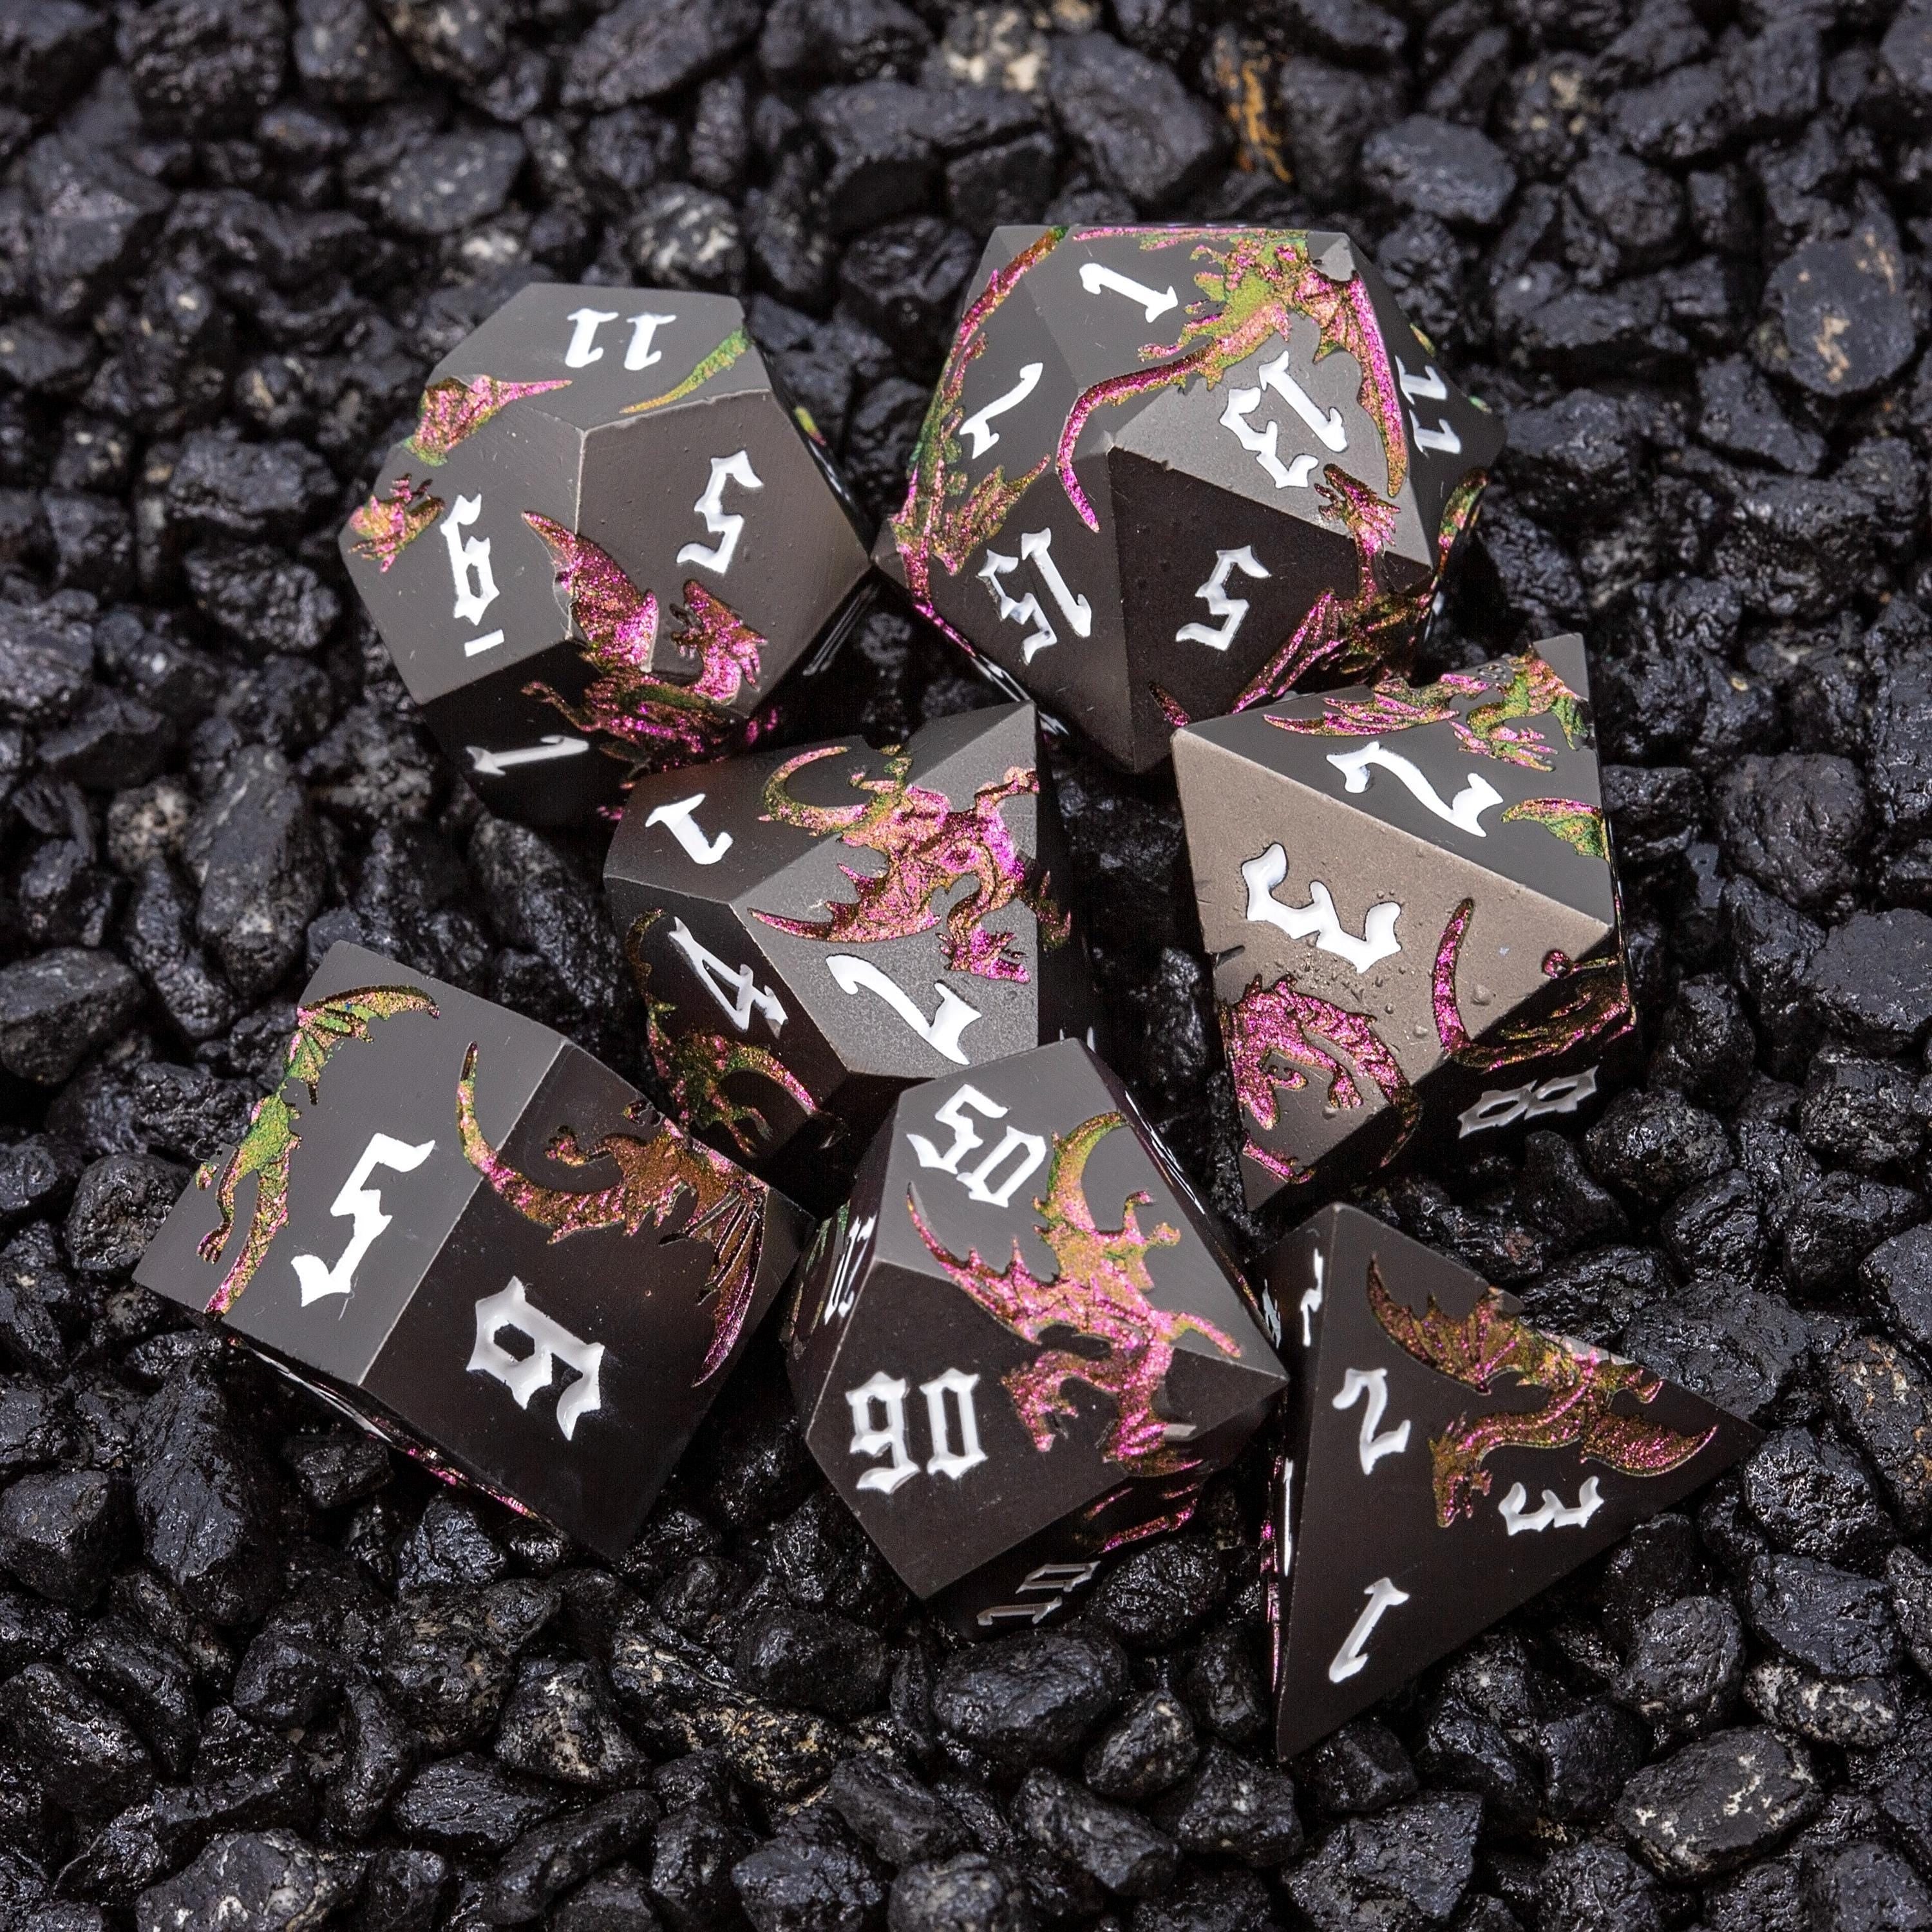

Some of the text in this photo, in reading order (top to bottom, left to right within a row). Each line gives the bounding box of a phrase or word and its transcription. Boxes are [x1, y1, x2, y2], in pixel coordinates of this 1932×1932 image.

[564, 307, 677, 372] 11
[1078, 261, 1179, 324] 1
[1218, 349, 1349, 489] 13
[1392, 354, 1462, 457] 11
[439, 493, 501, 627] 6
[676, 450, 764, 576] 5
[978, 527, 1093, 665] 15
[1175, 544, 1273, 652] 5
[465, 734, 590, 776] 1
[644, 793, 734, 866] 1
[1241, 843, 1402, 976] 3
[667, 916, 790, 1039] 4
[905, 1083, 1048, 1209] 50
[1457, 1065, 1599, 1139] 8
[290, 1132, 437, 1308] 5
[844, 1367, 989, 1496] 90
[1331, 1367, 1412, 1476] 2
[1497, 1475, 1605, 1537] 3
[1328, 1576, 1410, 1684] 1
